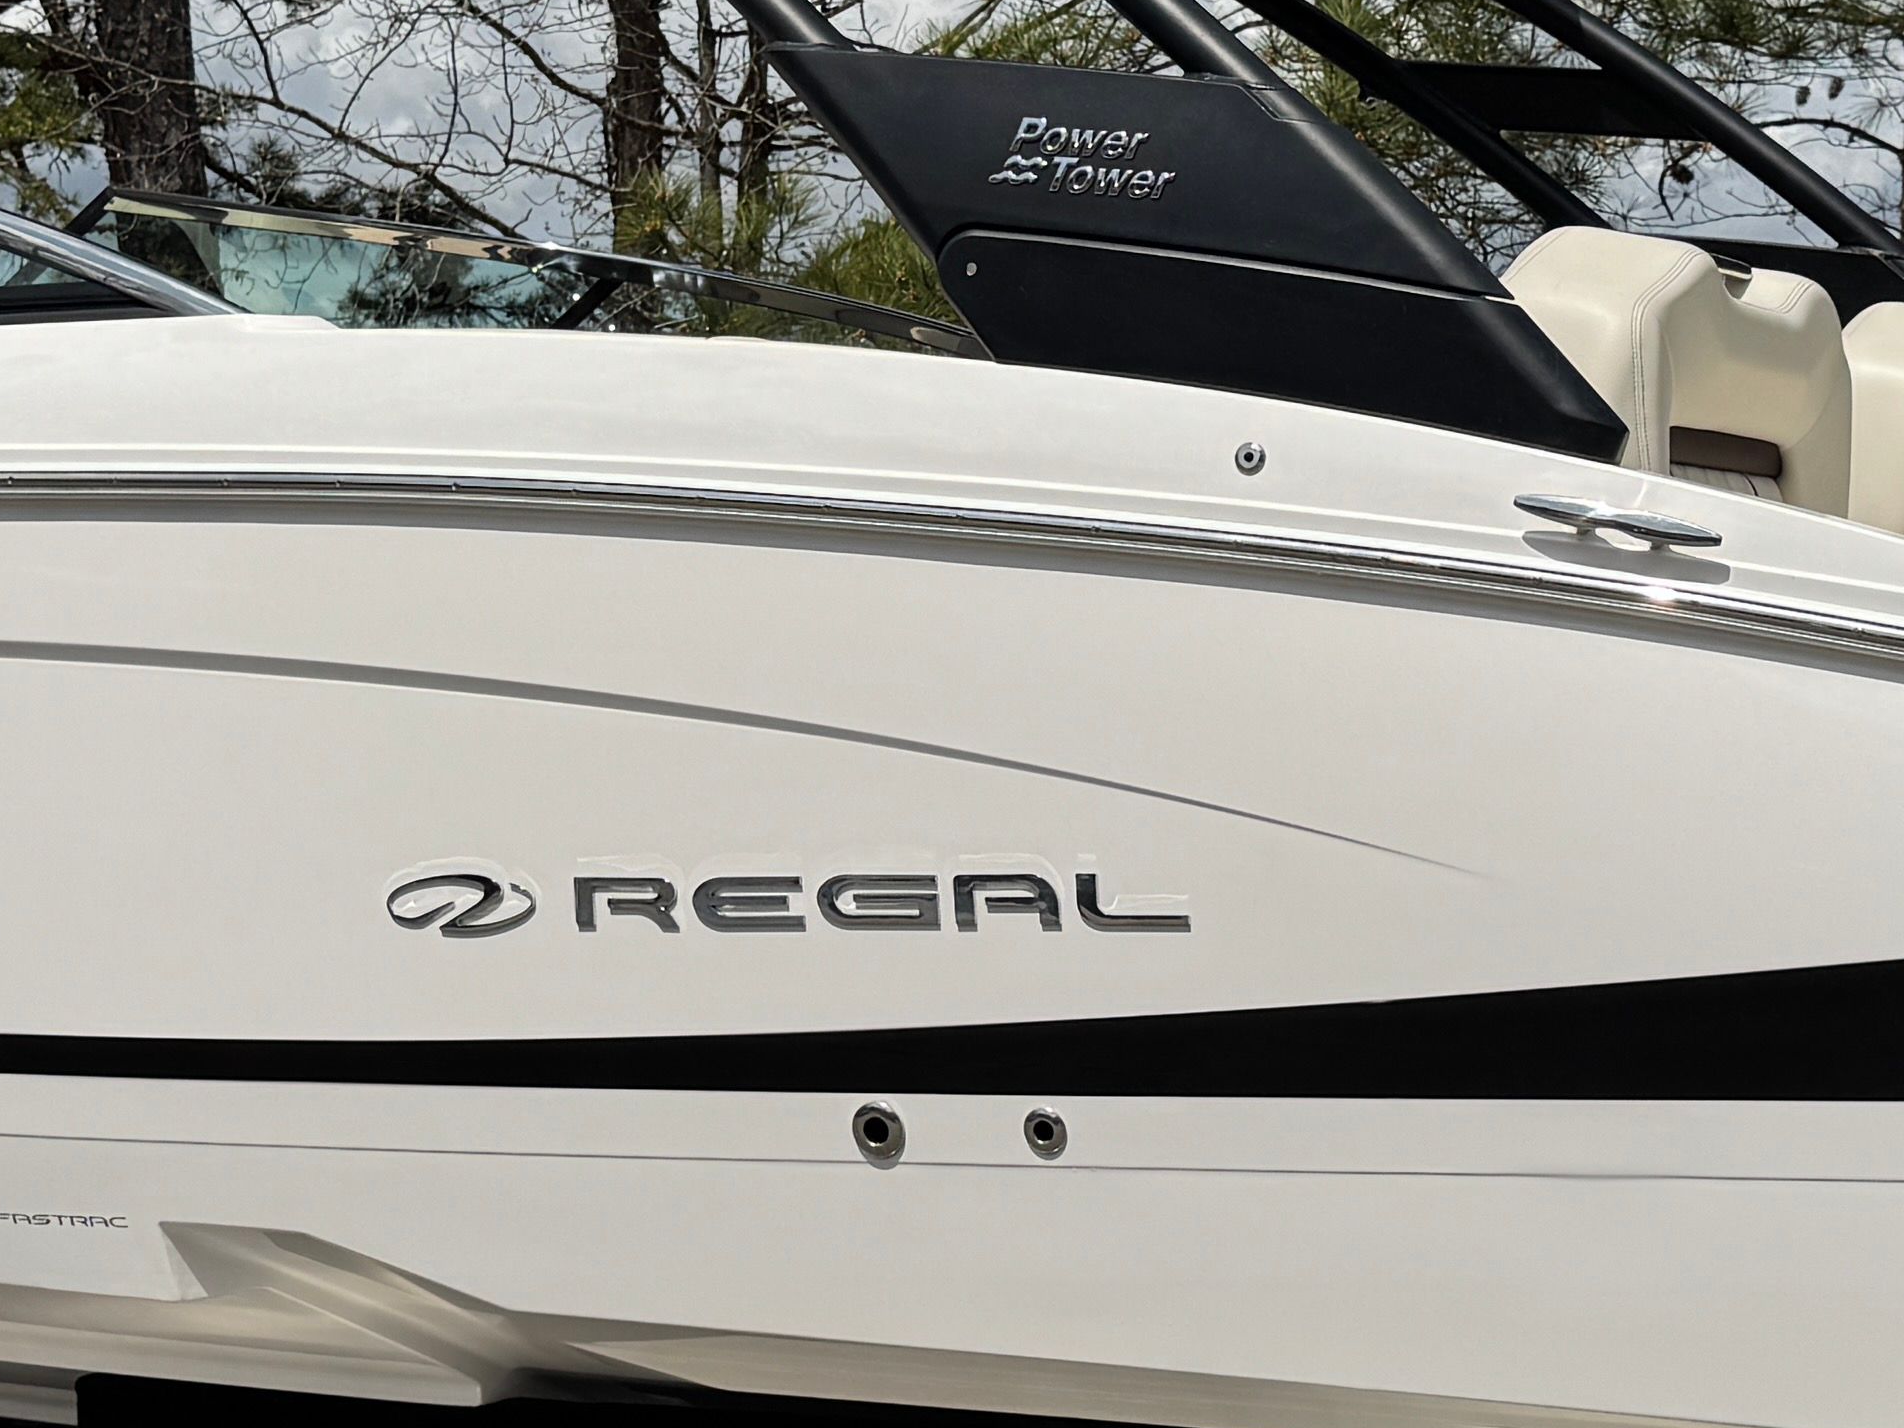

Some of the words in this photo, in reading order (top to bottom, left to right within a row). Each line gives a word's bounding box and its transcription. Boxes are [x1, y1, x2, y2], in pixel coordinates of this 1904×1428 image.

[1009, 116, 1150, 159] Power
[1049, 156, 1175, 199] Tower
[574, 874, 1191, 933] REGAL
